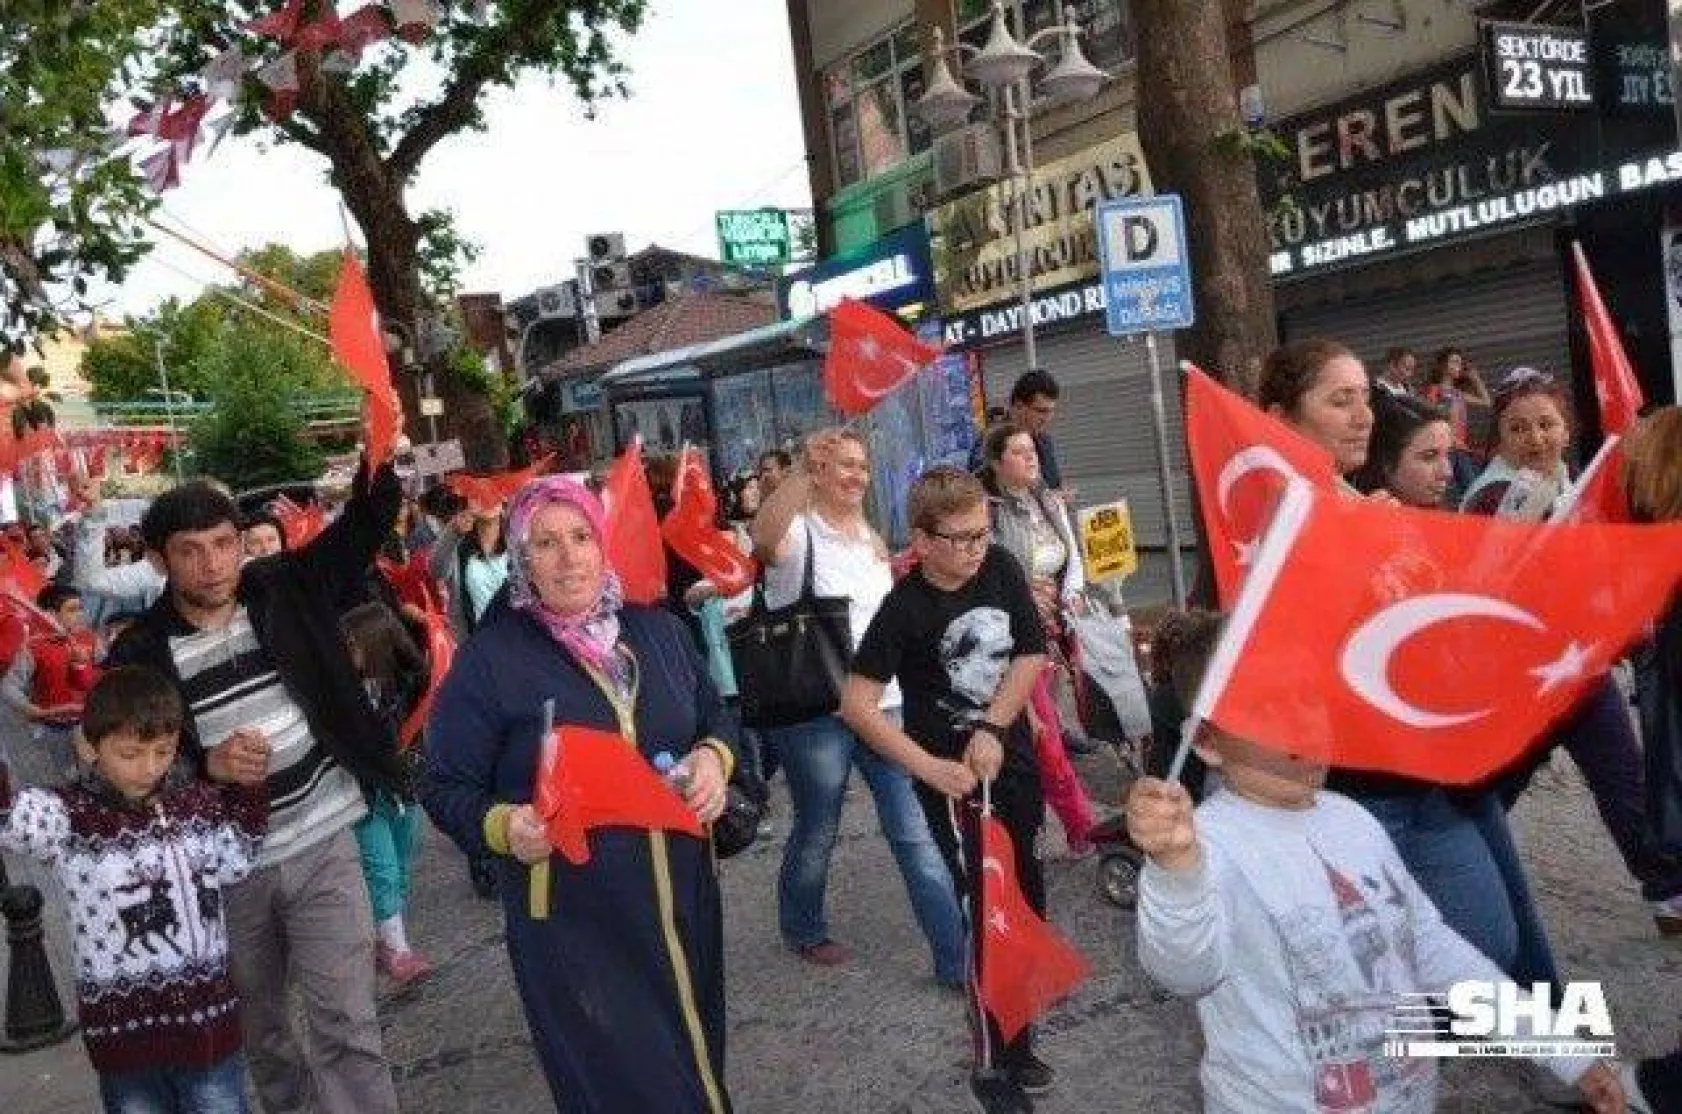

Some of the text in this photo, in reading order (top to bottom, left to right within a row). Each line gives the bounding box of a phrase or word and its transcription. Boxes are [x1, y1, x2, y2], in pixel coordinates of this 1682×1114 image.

[1497, 34, 1587, 63] SEKTÖRDE
[1502, 60, 1592, 101] 23 YIL
[1298, 73, 1480, 181] EREN
[1122, 215, 1159, 263] D
